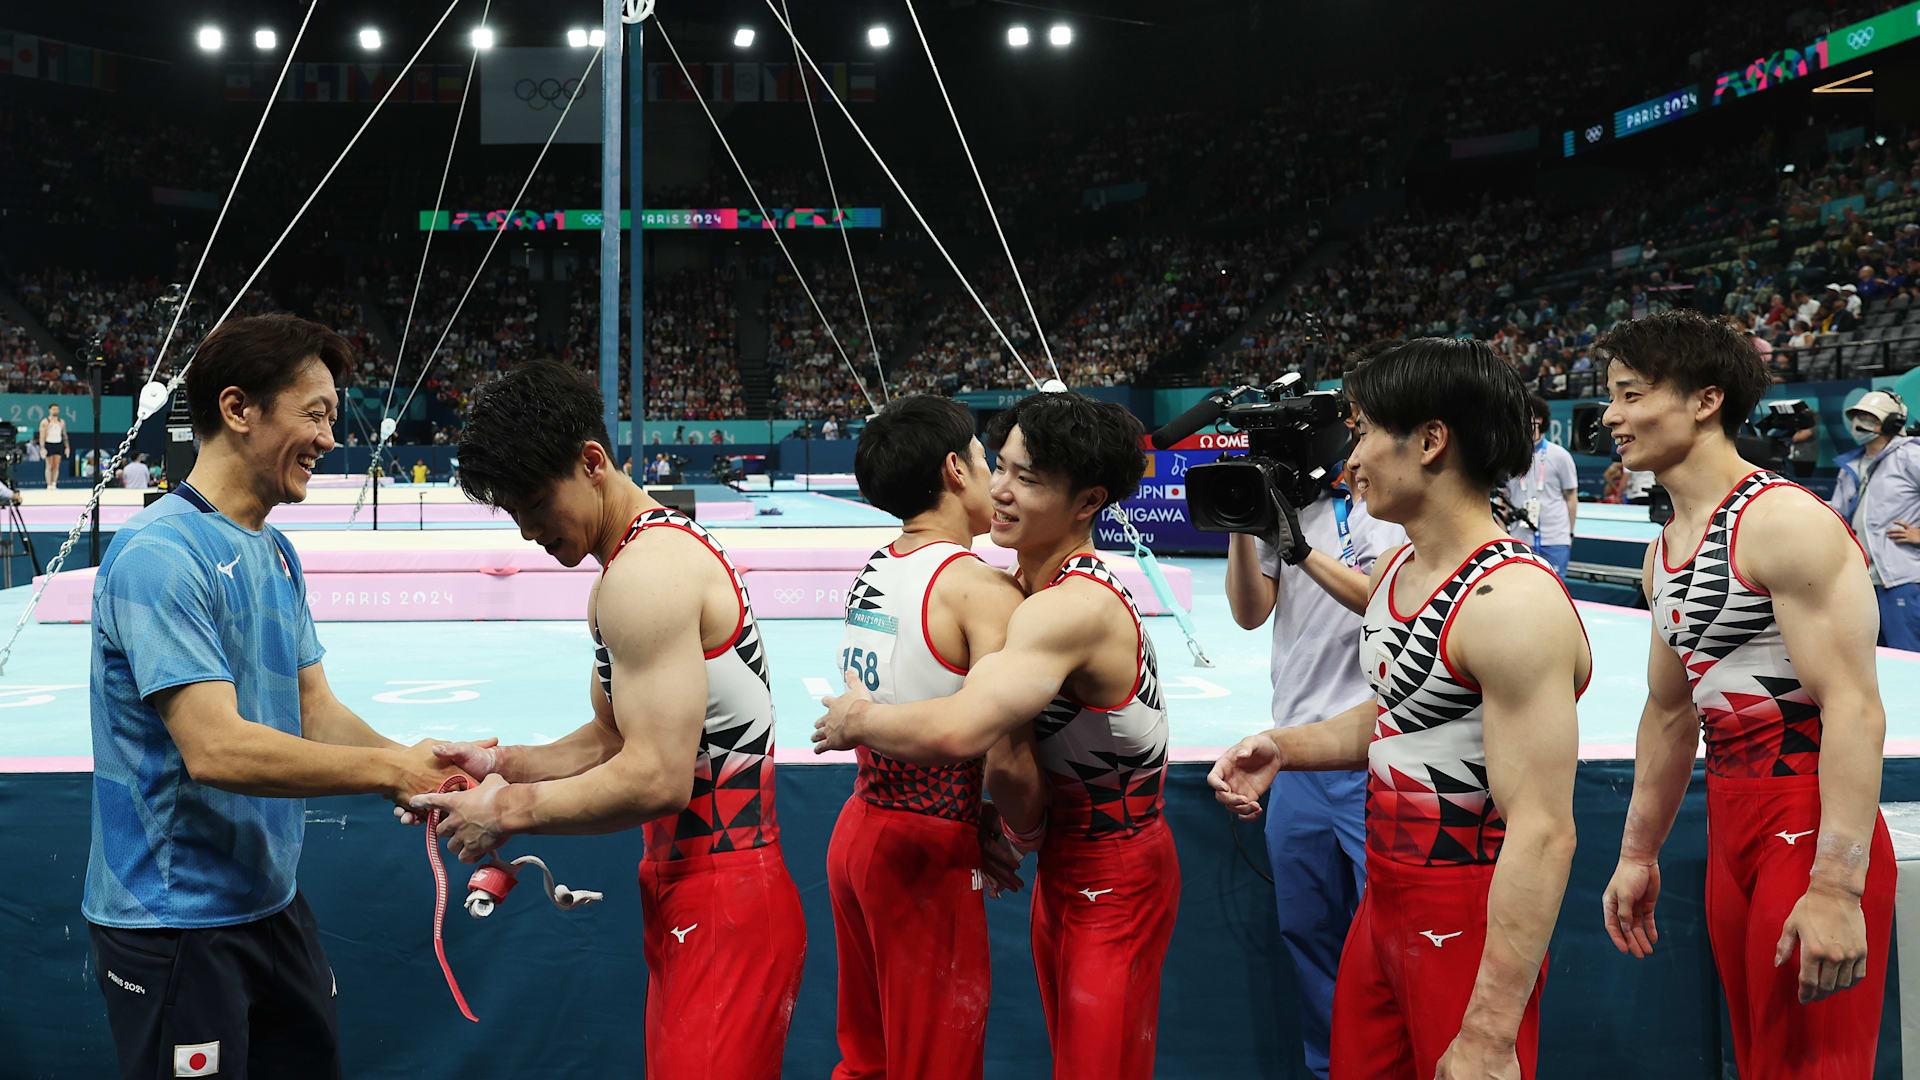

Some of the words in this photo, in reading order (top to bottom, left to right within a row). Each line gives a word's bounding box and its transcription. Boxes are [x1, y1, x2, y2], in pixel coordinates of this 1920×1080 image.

[1626, 104, 1661, 128] PARIS
[1664, 92, 1697, 115] 2024
[684, 214, 721, 224] 2024
[11, 404, 76, 422] 204
[1216, 435, 1249, 448] OME
[1135, 485, 1164, 500] JPN
[1099, 528, 1155, 543] Watru
[332, 591, 391, 605] PARIS
[400, 591, 454, 605] 2024
[842, 647, 881, 692] 158
[124, 981, 146, 995] 2024
